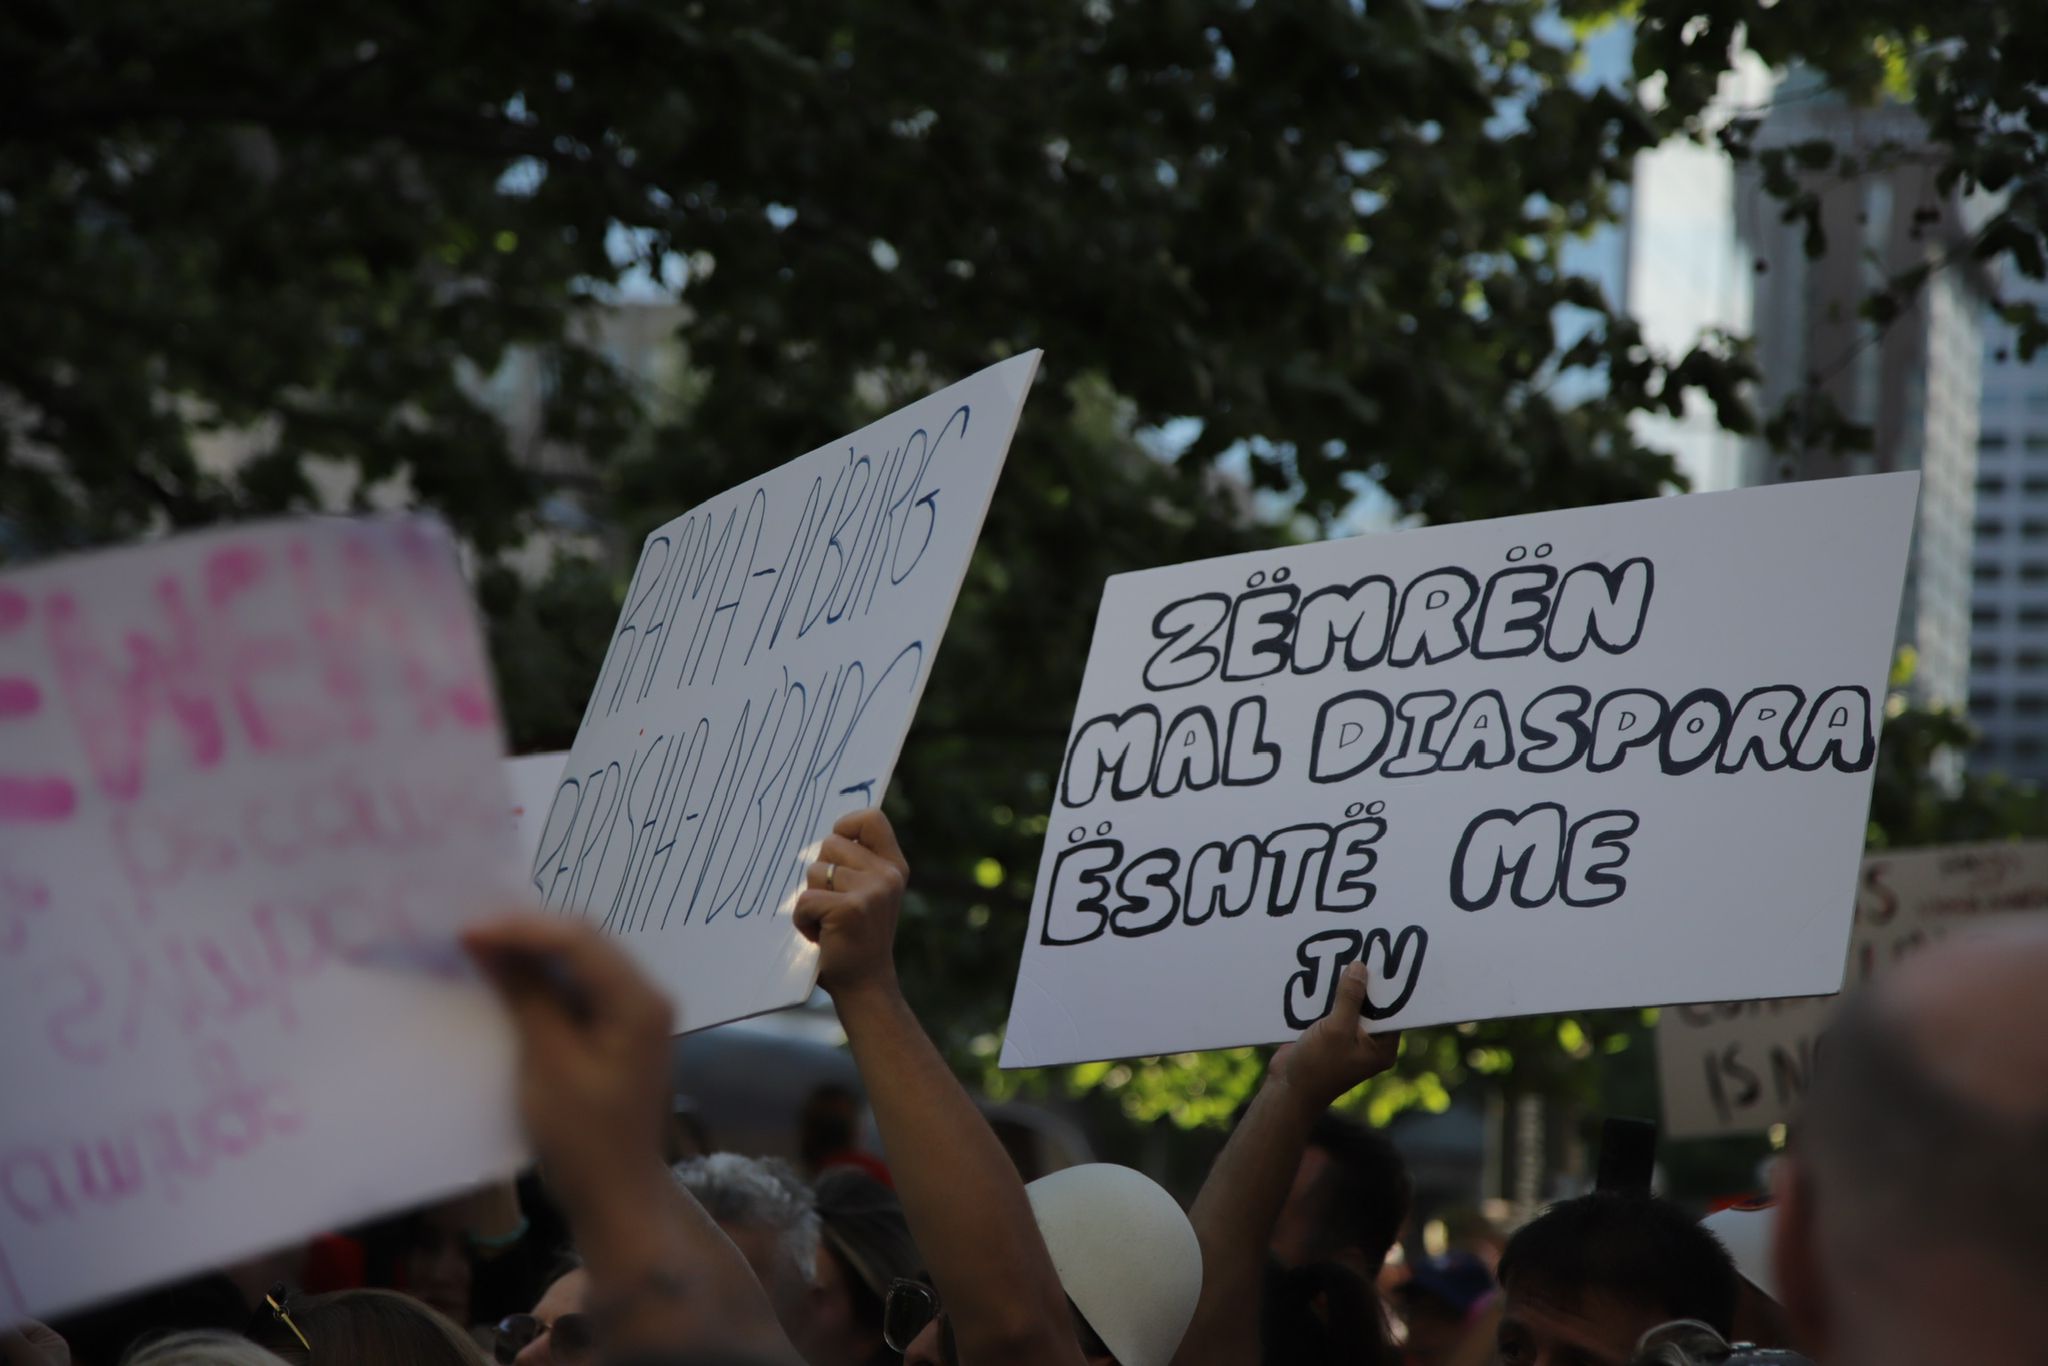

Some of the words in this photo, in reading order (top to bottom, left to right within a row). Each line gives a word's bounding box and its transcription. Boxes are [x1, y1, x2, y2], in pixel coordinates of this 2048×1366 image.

[1142, 541, 1655, 692] ZËMRËN
[1060, 695, 1282, 809] MAL
[1308, 684, 1876, 785] DIASPORA
[1039, 799, 1388, 947] ËSHTË
[1449, 801, 1640, 913] ME
